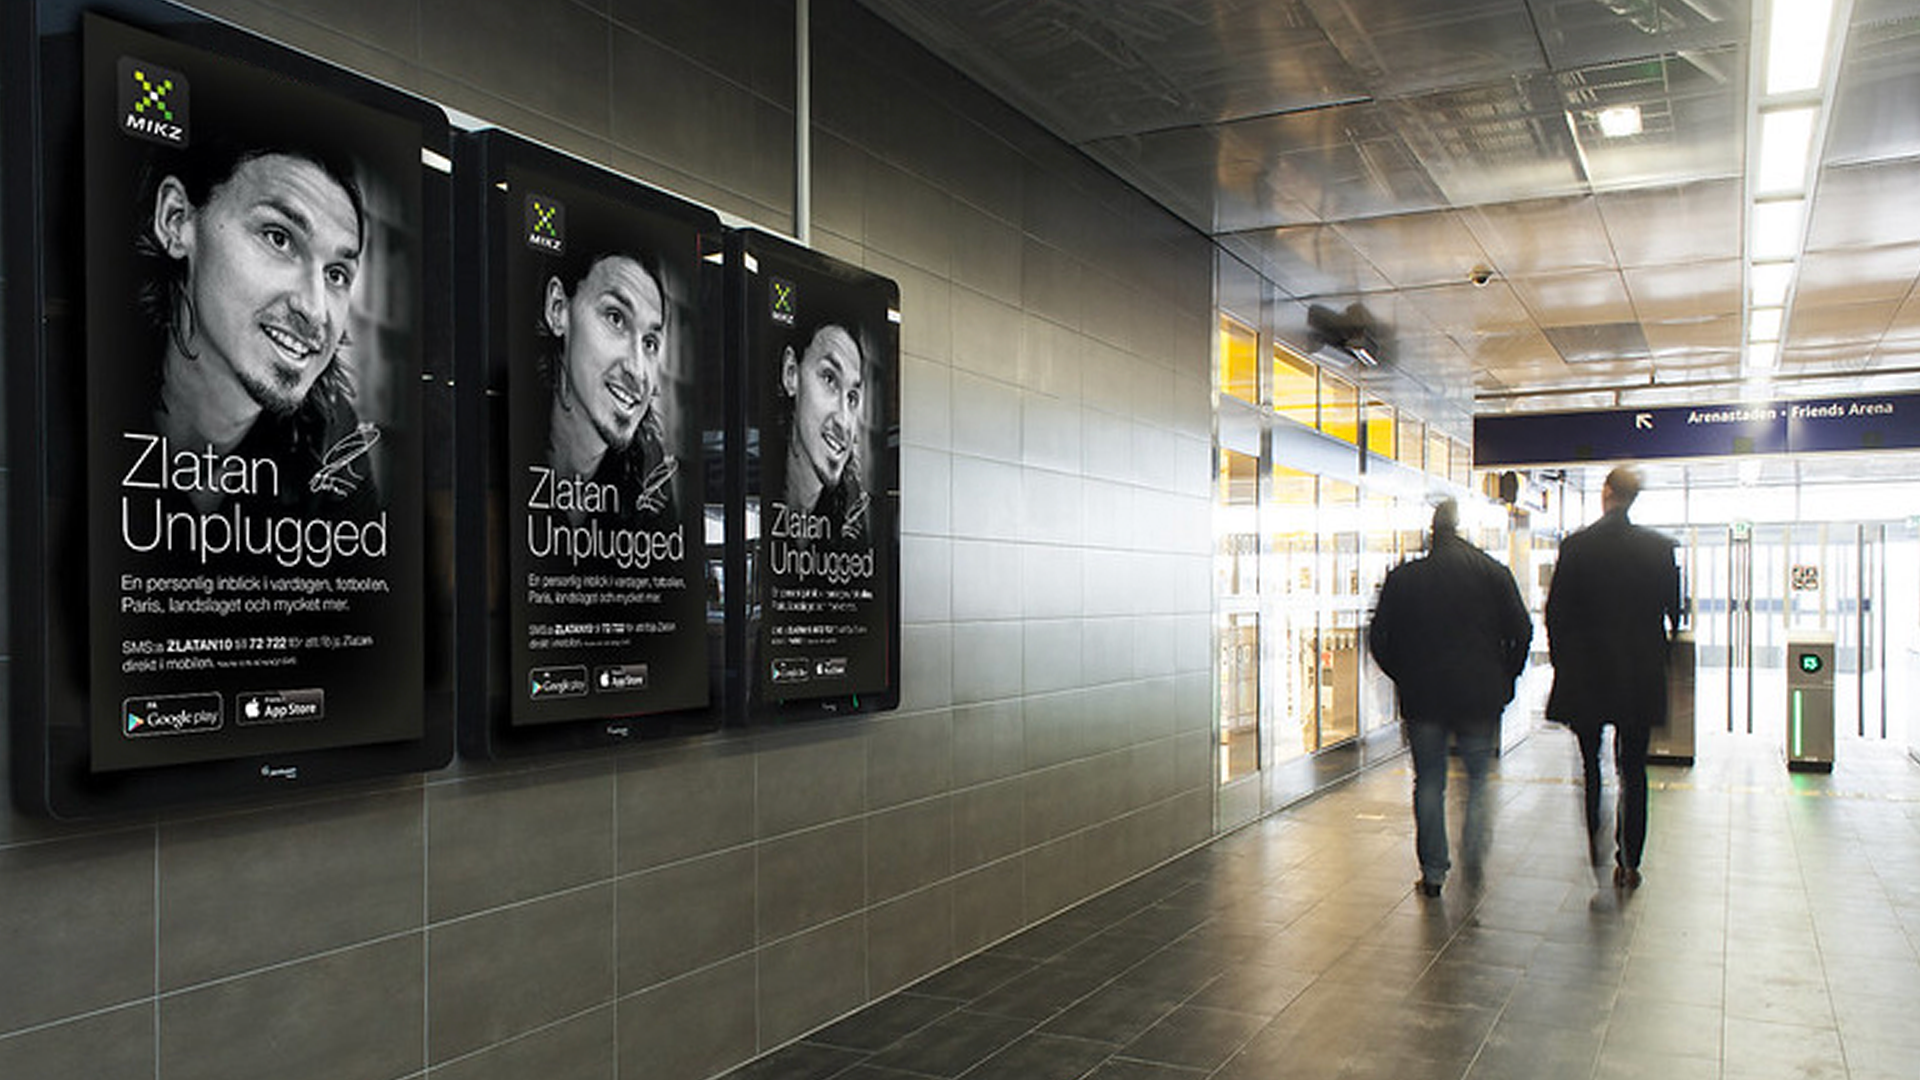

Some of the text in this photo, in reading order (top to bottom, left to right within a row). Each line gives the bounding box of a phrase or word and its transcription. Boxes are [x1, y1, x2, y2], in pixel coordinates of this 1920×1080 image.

[126, 114, 183, 140] MIKZ
[529, 233, 562, 251] MIKZ
[1687, 401, 1893, 425] Arenastaden Friends Arena
[121, 432, 279, 497] Zlatan
[527, 465, 620, 514] Zlatan
[121, 496, 387, 568] Unplugged
[771, 502, 831, 540] Zlatan
[527, 514, 684, 570] Unplugged
[770, 541, 875, 584] Unplugged
[121, 574, 142, 591] En
[146, 575, 214, 595] personlig
[244, 597, 271, 613] och
[166, 637, 233, 653] ZLATAN10
[249, 636, 265, 651] 72
[266, 635, 287, 650] 722
[146, 709, 219, 730] Google play
[263, 702, 318, 719] App Store
